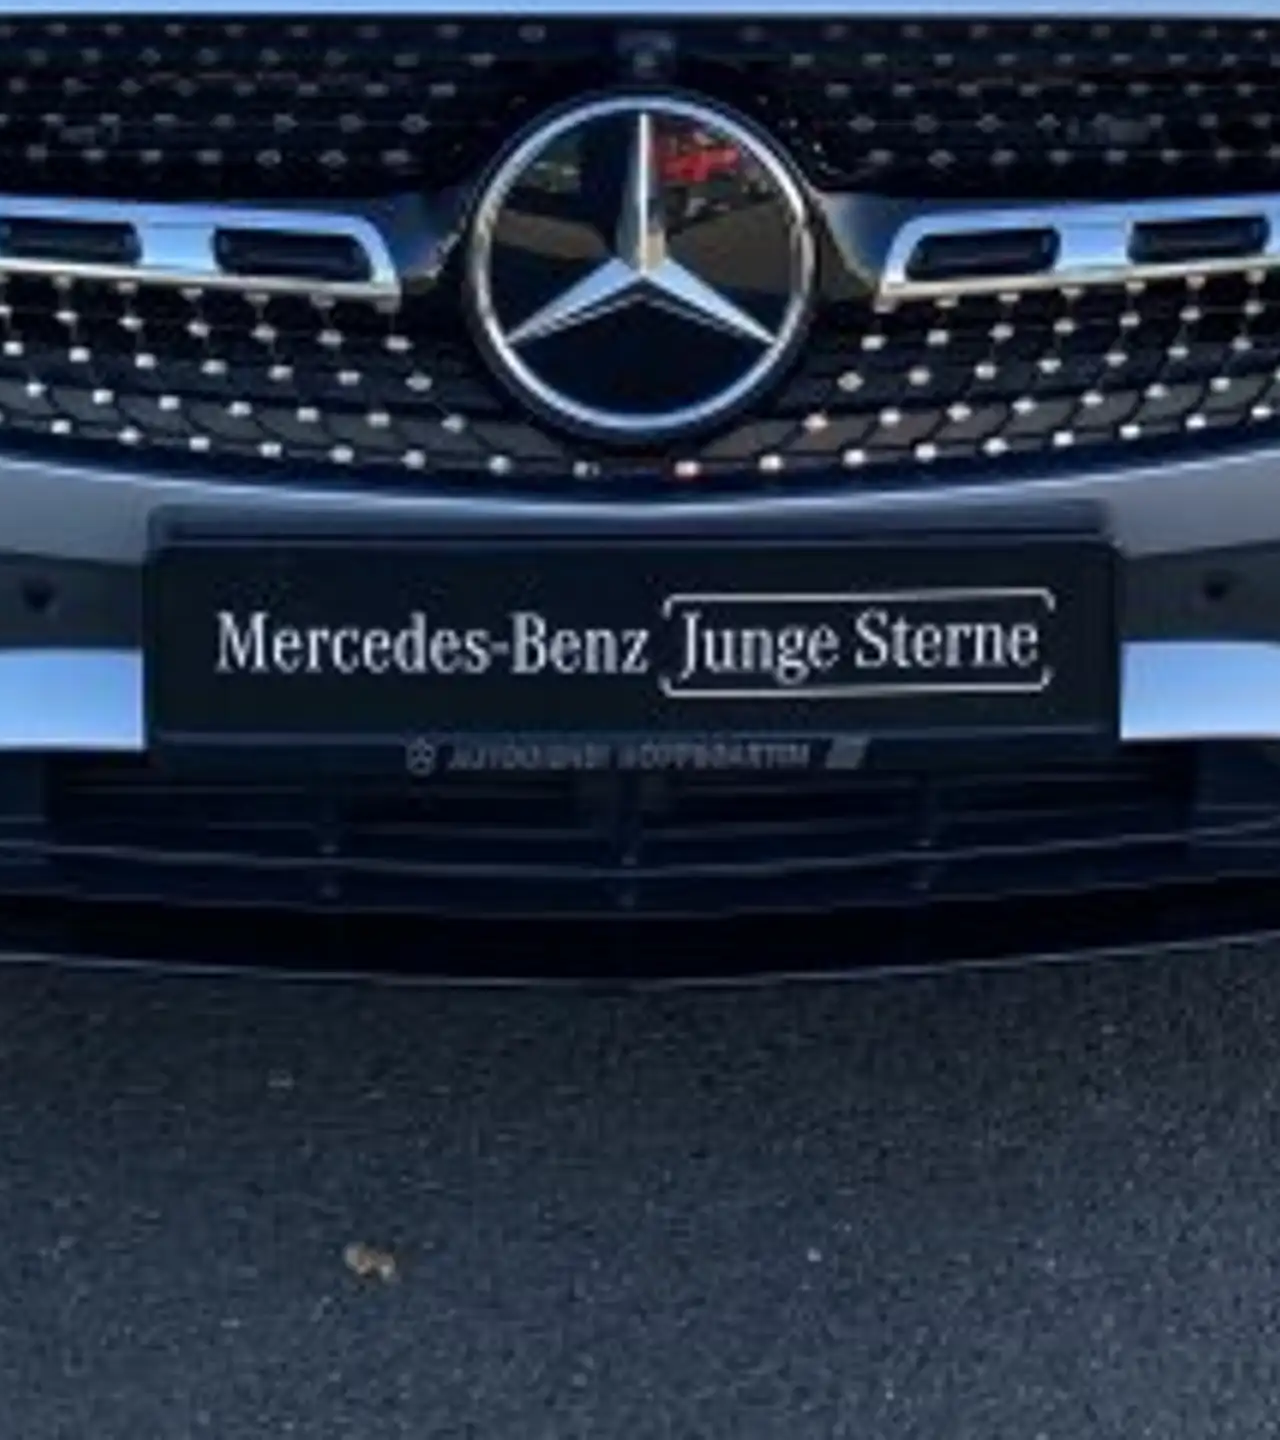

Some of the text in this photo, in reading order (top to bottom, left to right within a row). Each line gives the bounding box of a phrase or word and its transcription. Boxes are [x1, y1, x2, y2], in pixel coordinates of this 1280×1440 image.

[215, 607, 1039, 685] Mercedes-Benz Junge Sterne
